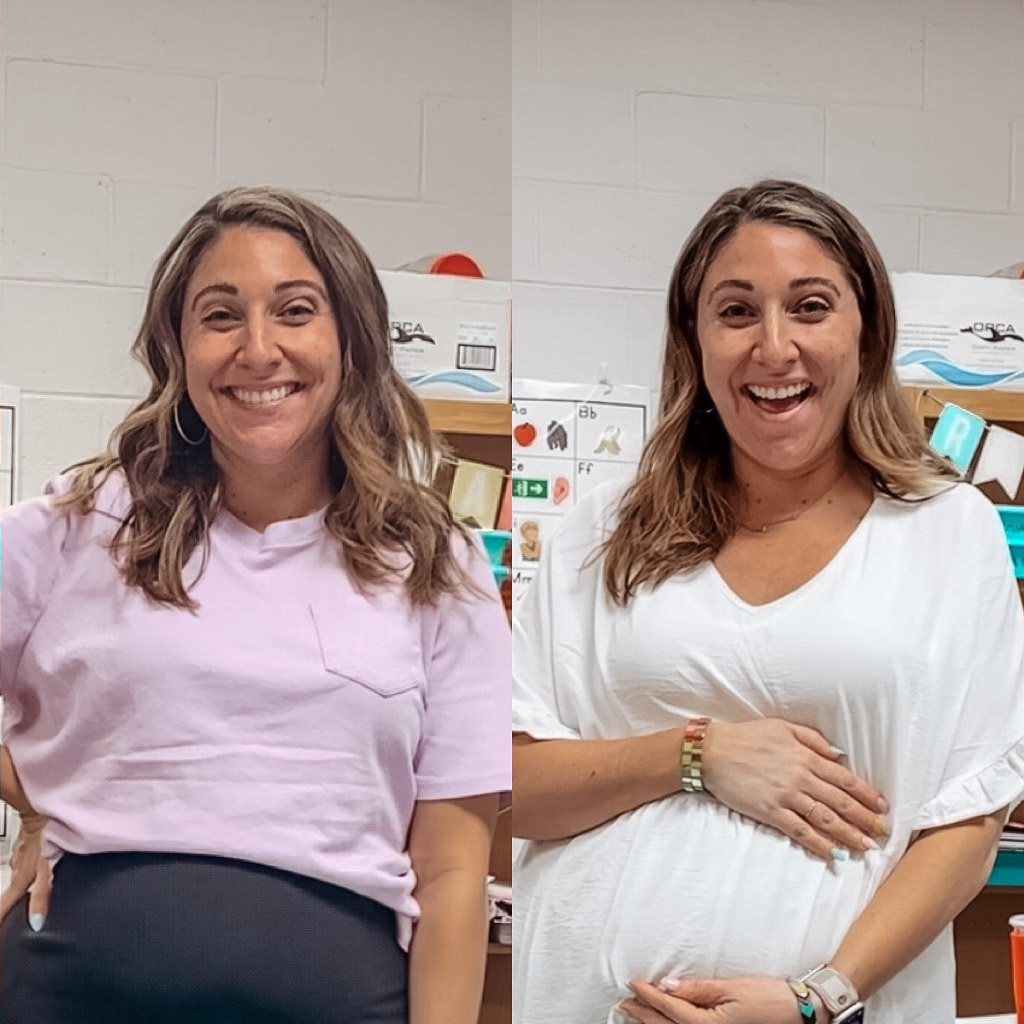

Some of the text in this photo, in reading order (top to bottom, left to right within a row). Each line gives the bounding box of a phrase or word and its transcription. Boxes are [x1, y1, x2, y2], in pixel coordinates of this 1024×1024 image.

[390, 321, 425, 333] RCA
[578, 406, 598, 420] Bb
[578, 461, 594, 475] Ff
